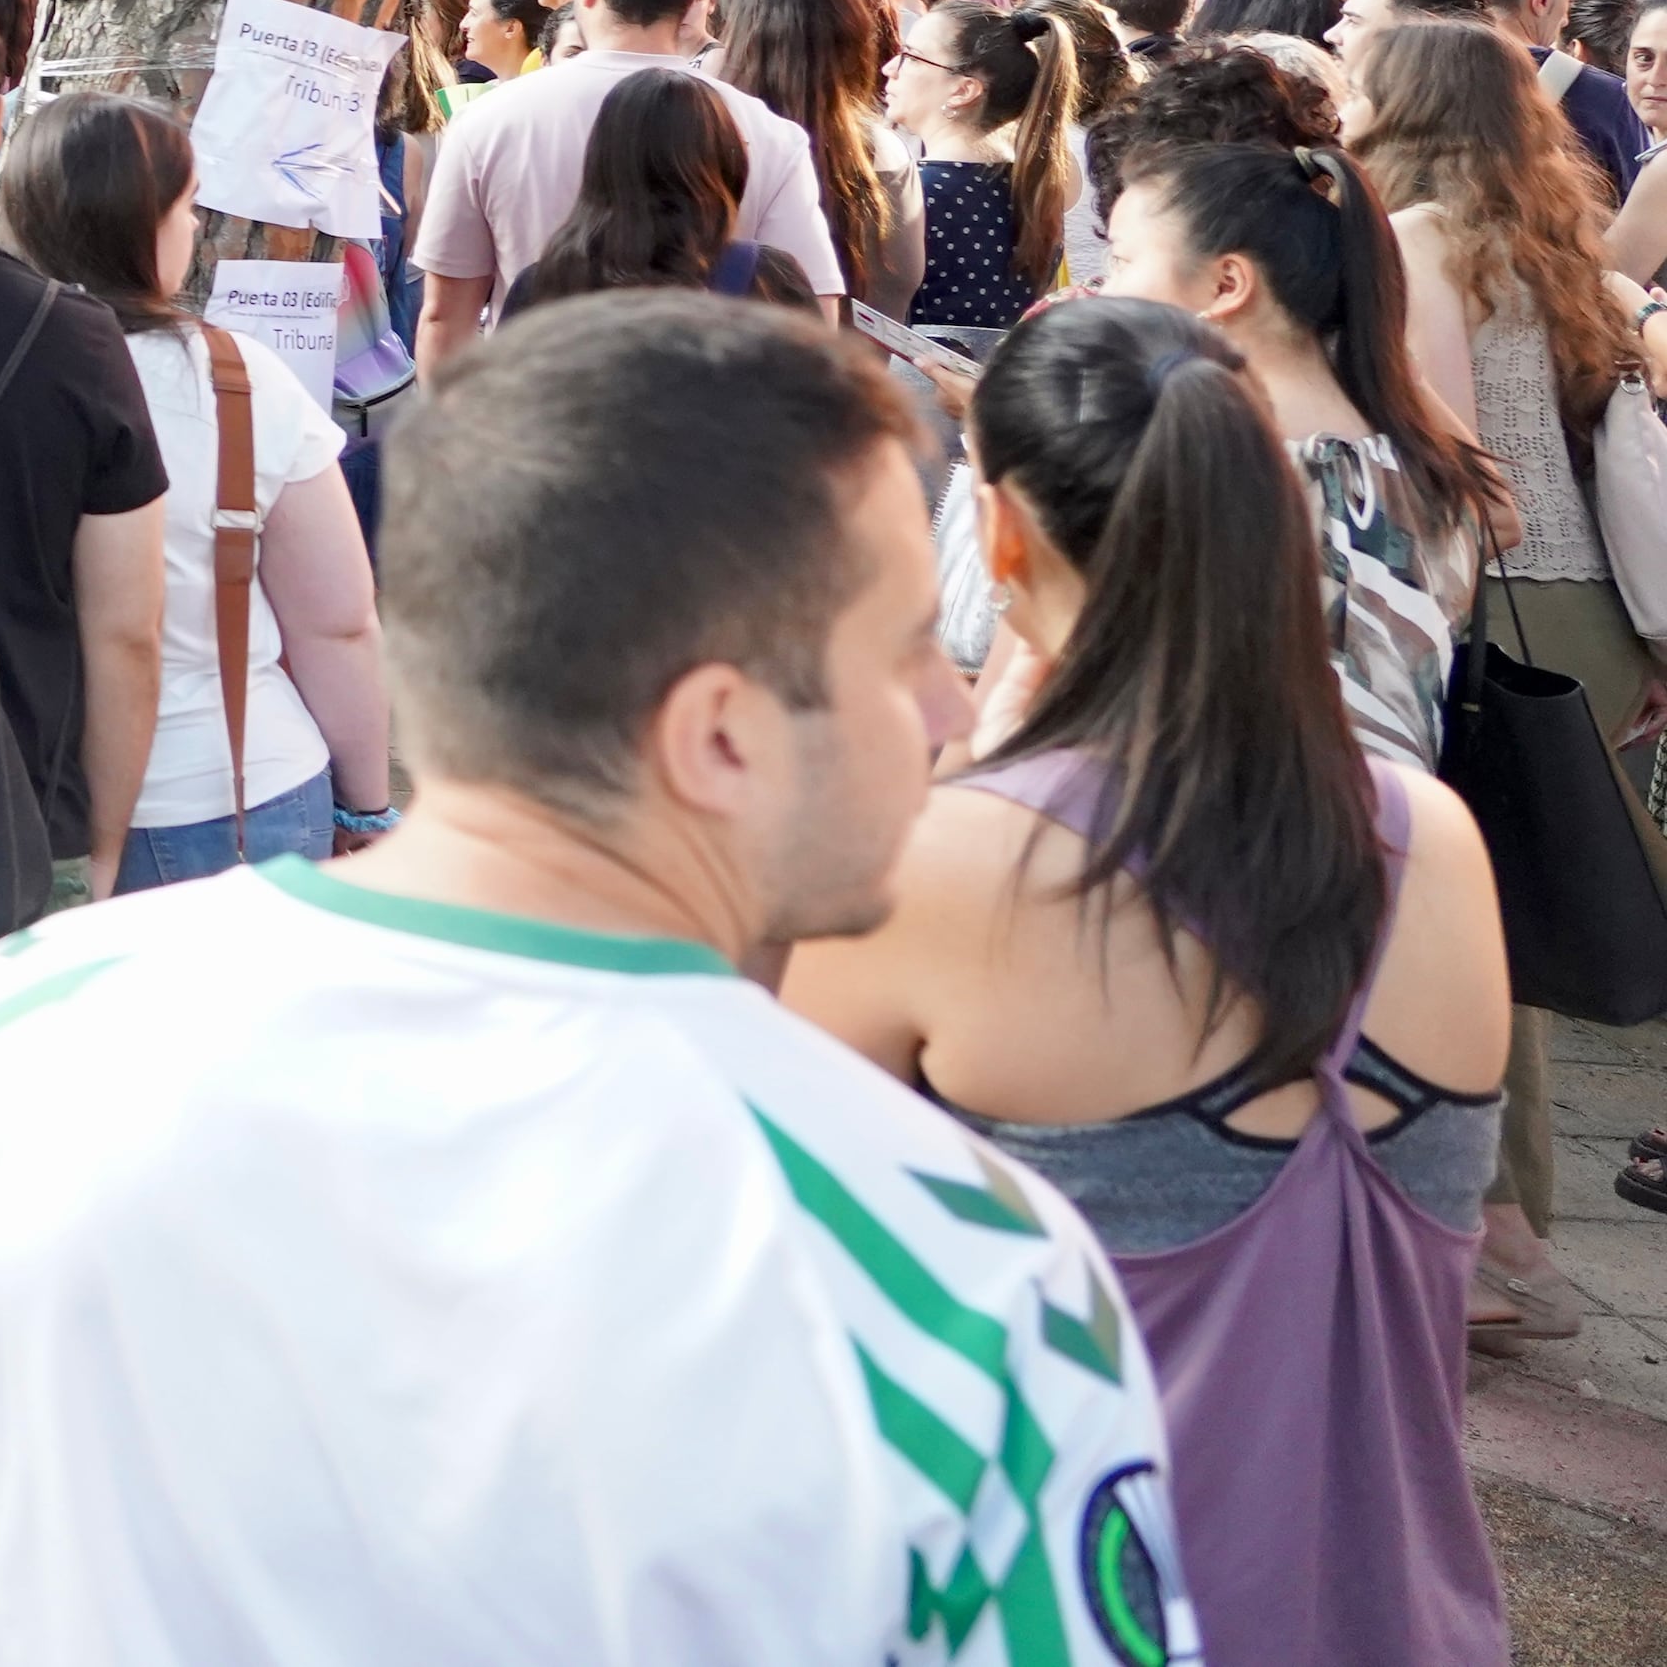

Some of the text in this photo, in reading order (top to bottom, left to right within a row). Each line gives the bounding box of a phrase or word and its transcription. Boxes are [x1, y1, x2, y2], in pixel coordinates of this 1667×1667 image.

[239, 22, 298, 52] Puerta
[284, 74, 347, 111] Tribun
[227, 290, 278, 307] Puerta
[282, 291, 298, 307] 03
[273, 327, 333, 351] Tribuna
